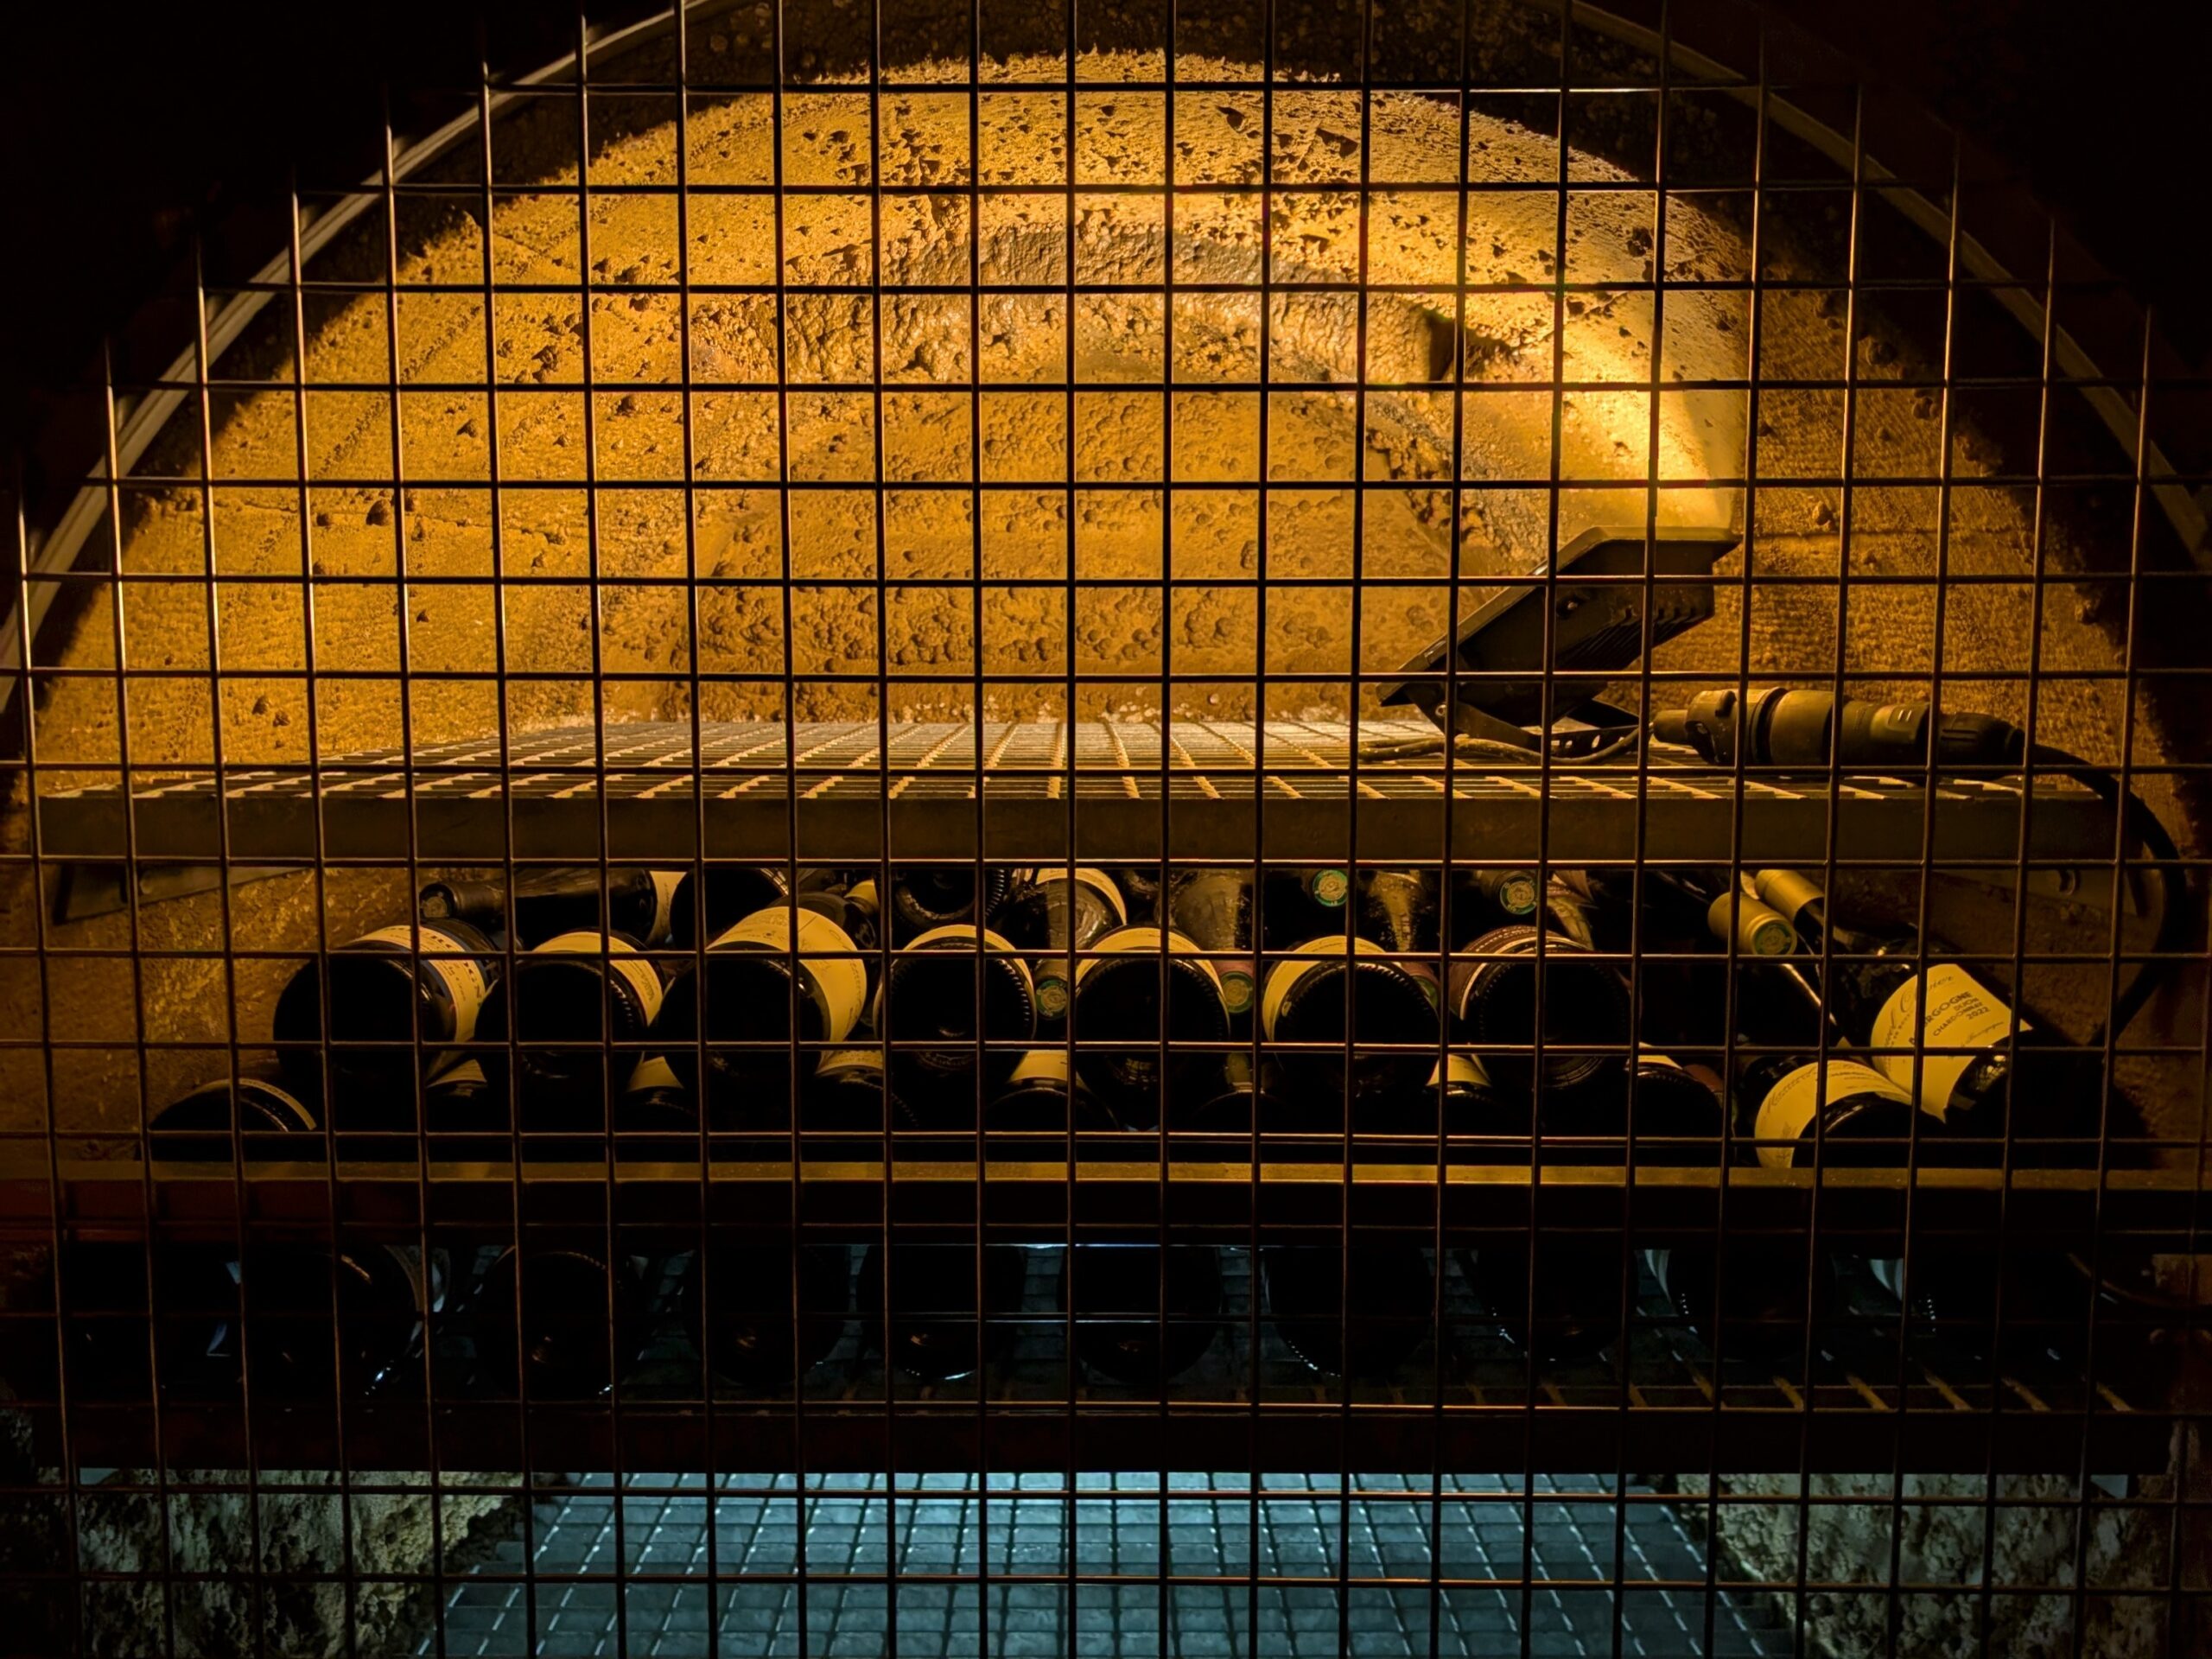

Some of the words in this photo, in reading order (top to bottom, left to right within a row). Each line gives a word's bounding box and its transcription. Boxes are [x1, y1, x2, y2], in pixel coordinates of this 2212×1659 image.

[1953, 997, 1980, 1011] DIJON
[1908, 991, 1974, 1046] BRGOGNE
[1966, 1007, 1991, 1020] 2022
